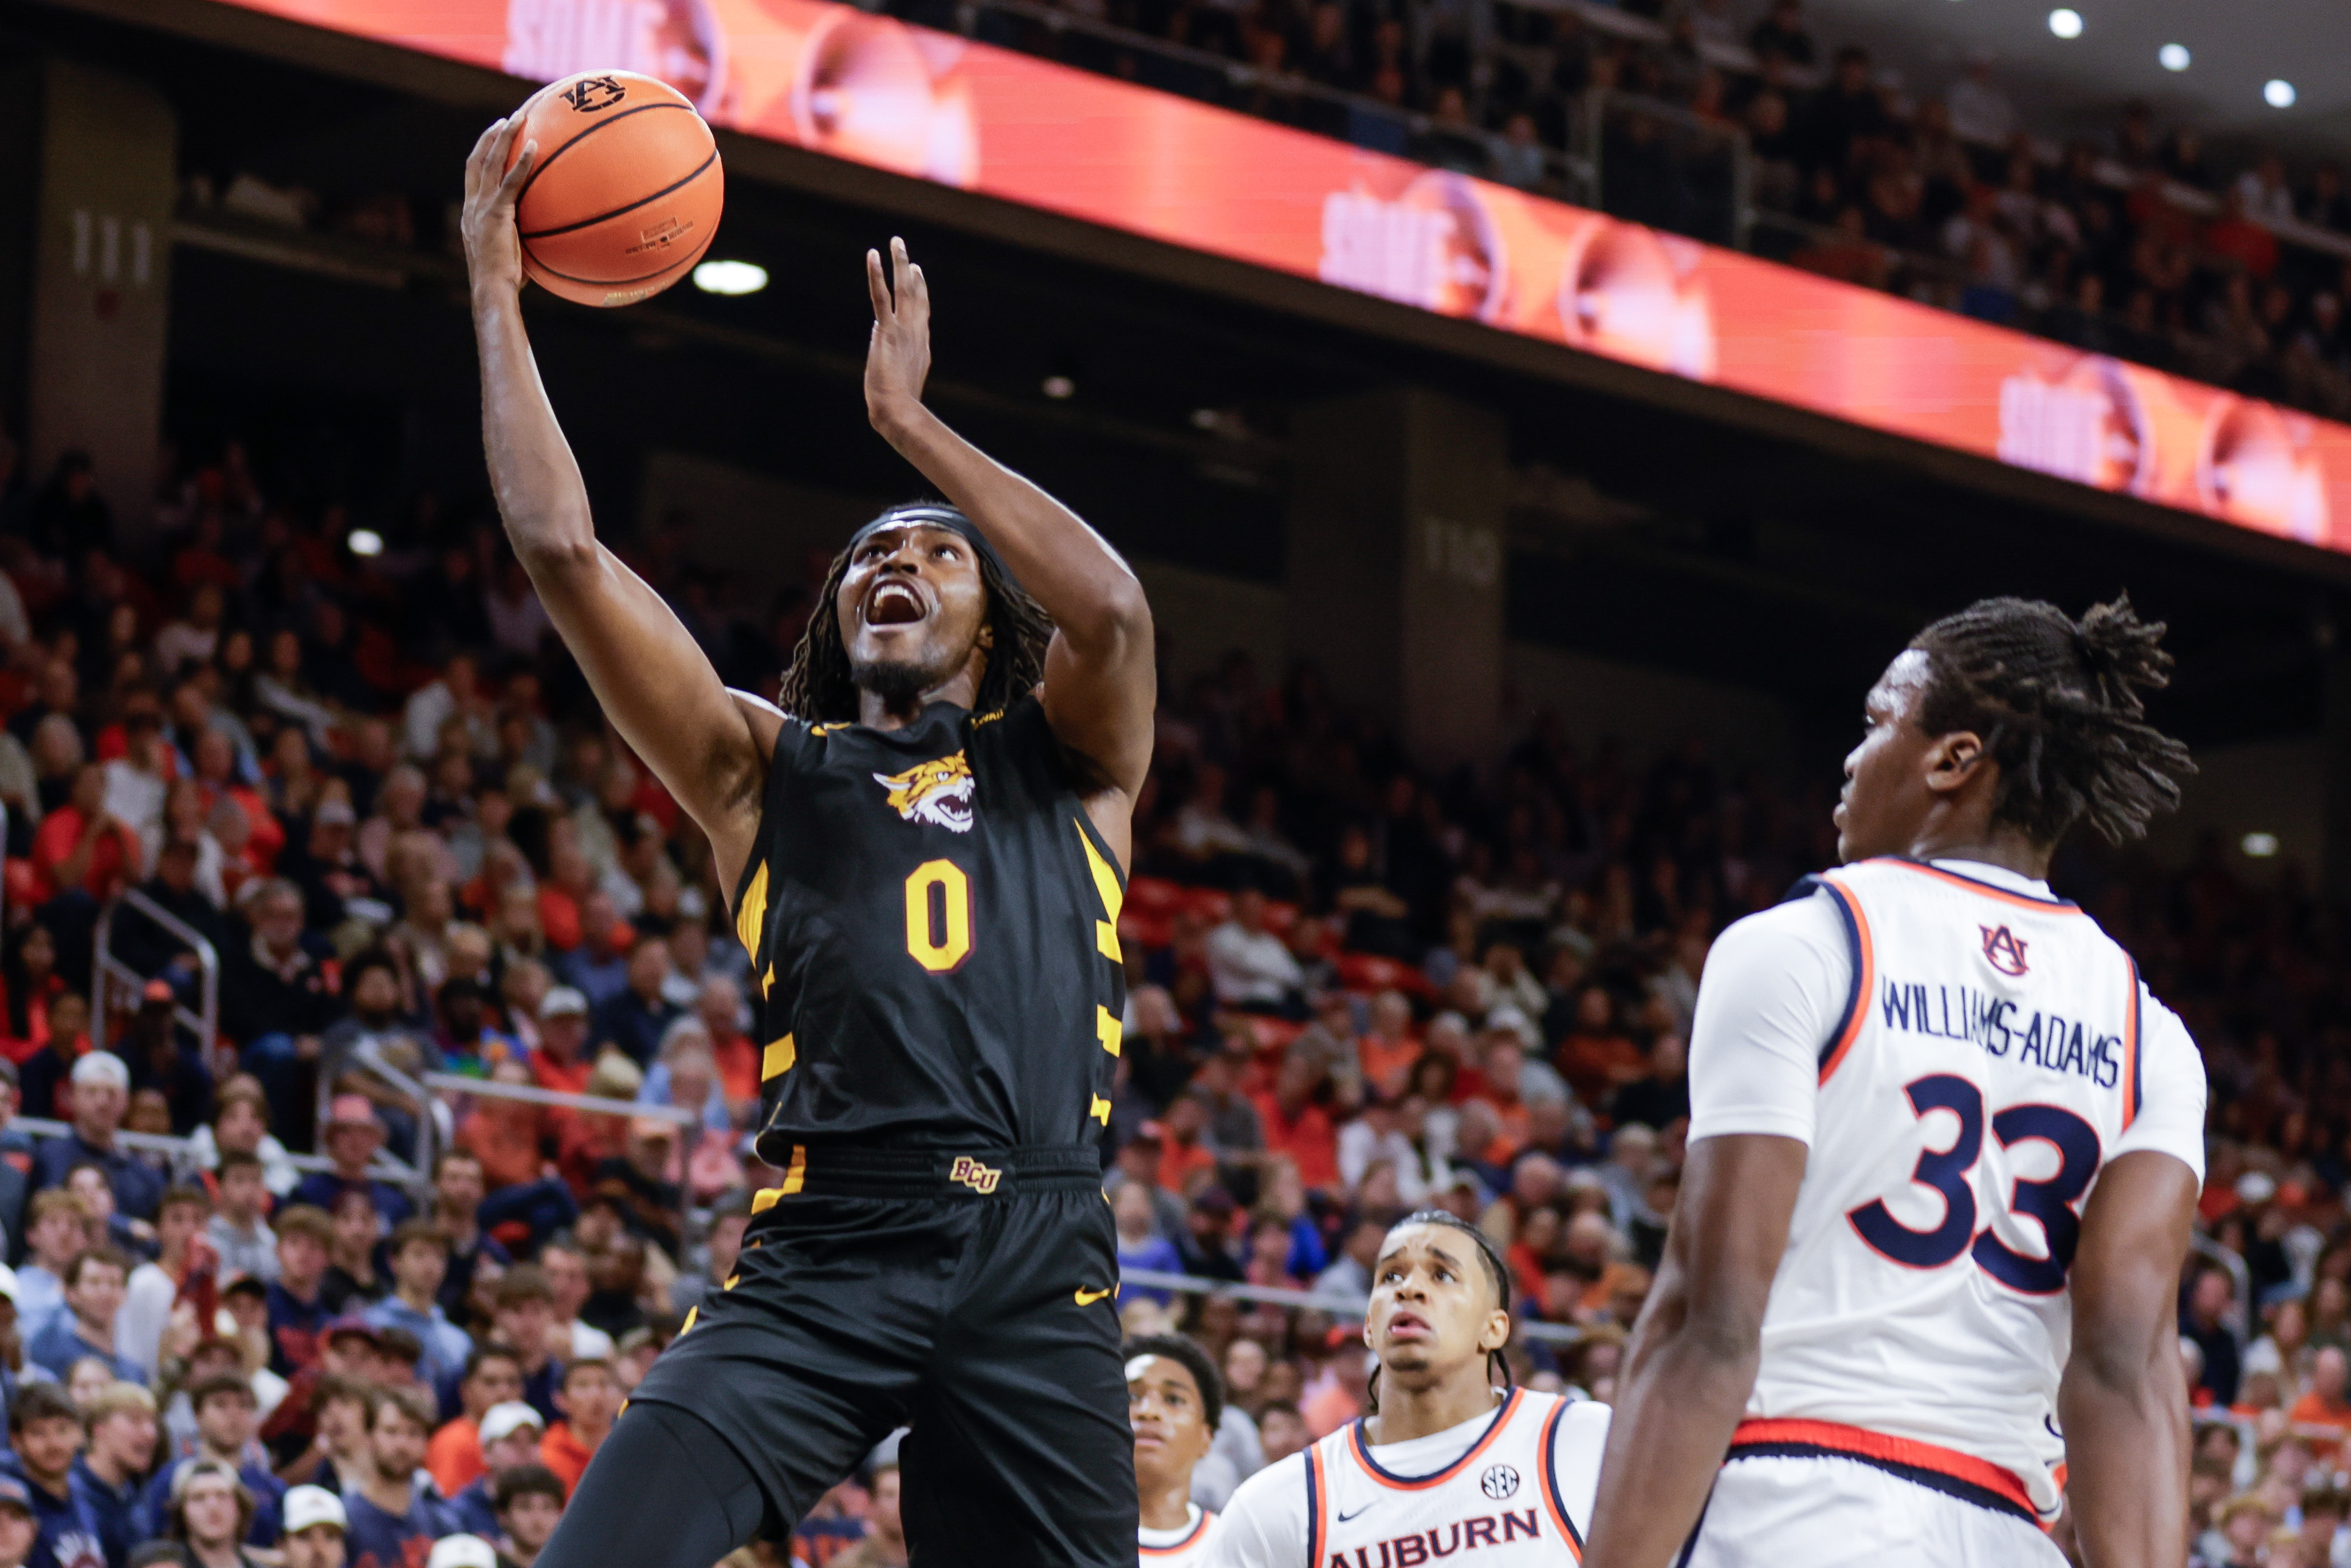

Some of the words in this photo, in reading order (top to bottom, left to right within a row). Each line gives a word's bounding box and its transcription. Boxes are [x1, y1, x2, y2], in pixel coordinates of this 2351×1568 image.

[904, 857, 974, 975] 0
[950, 1156, 1002, 1195] BCU
[1845, 1073, 2101, 1296] 33
[1481, 1464, 1519, 1499] SEC
